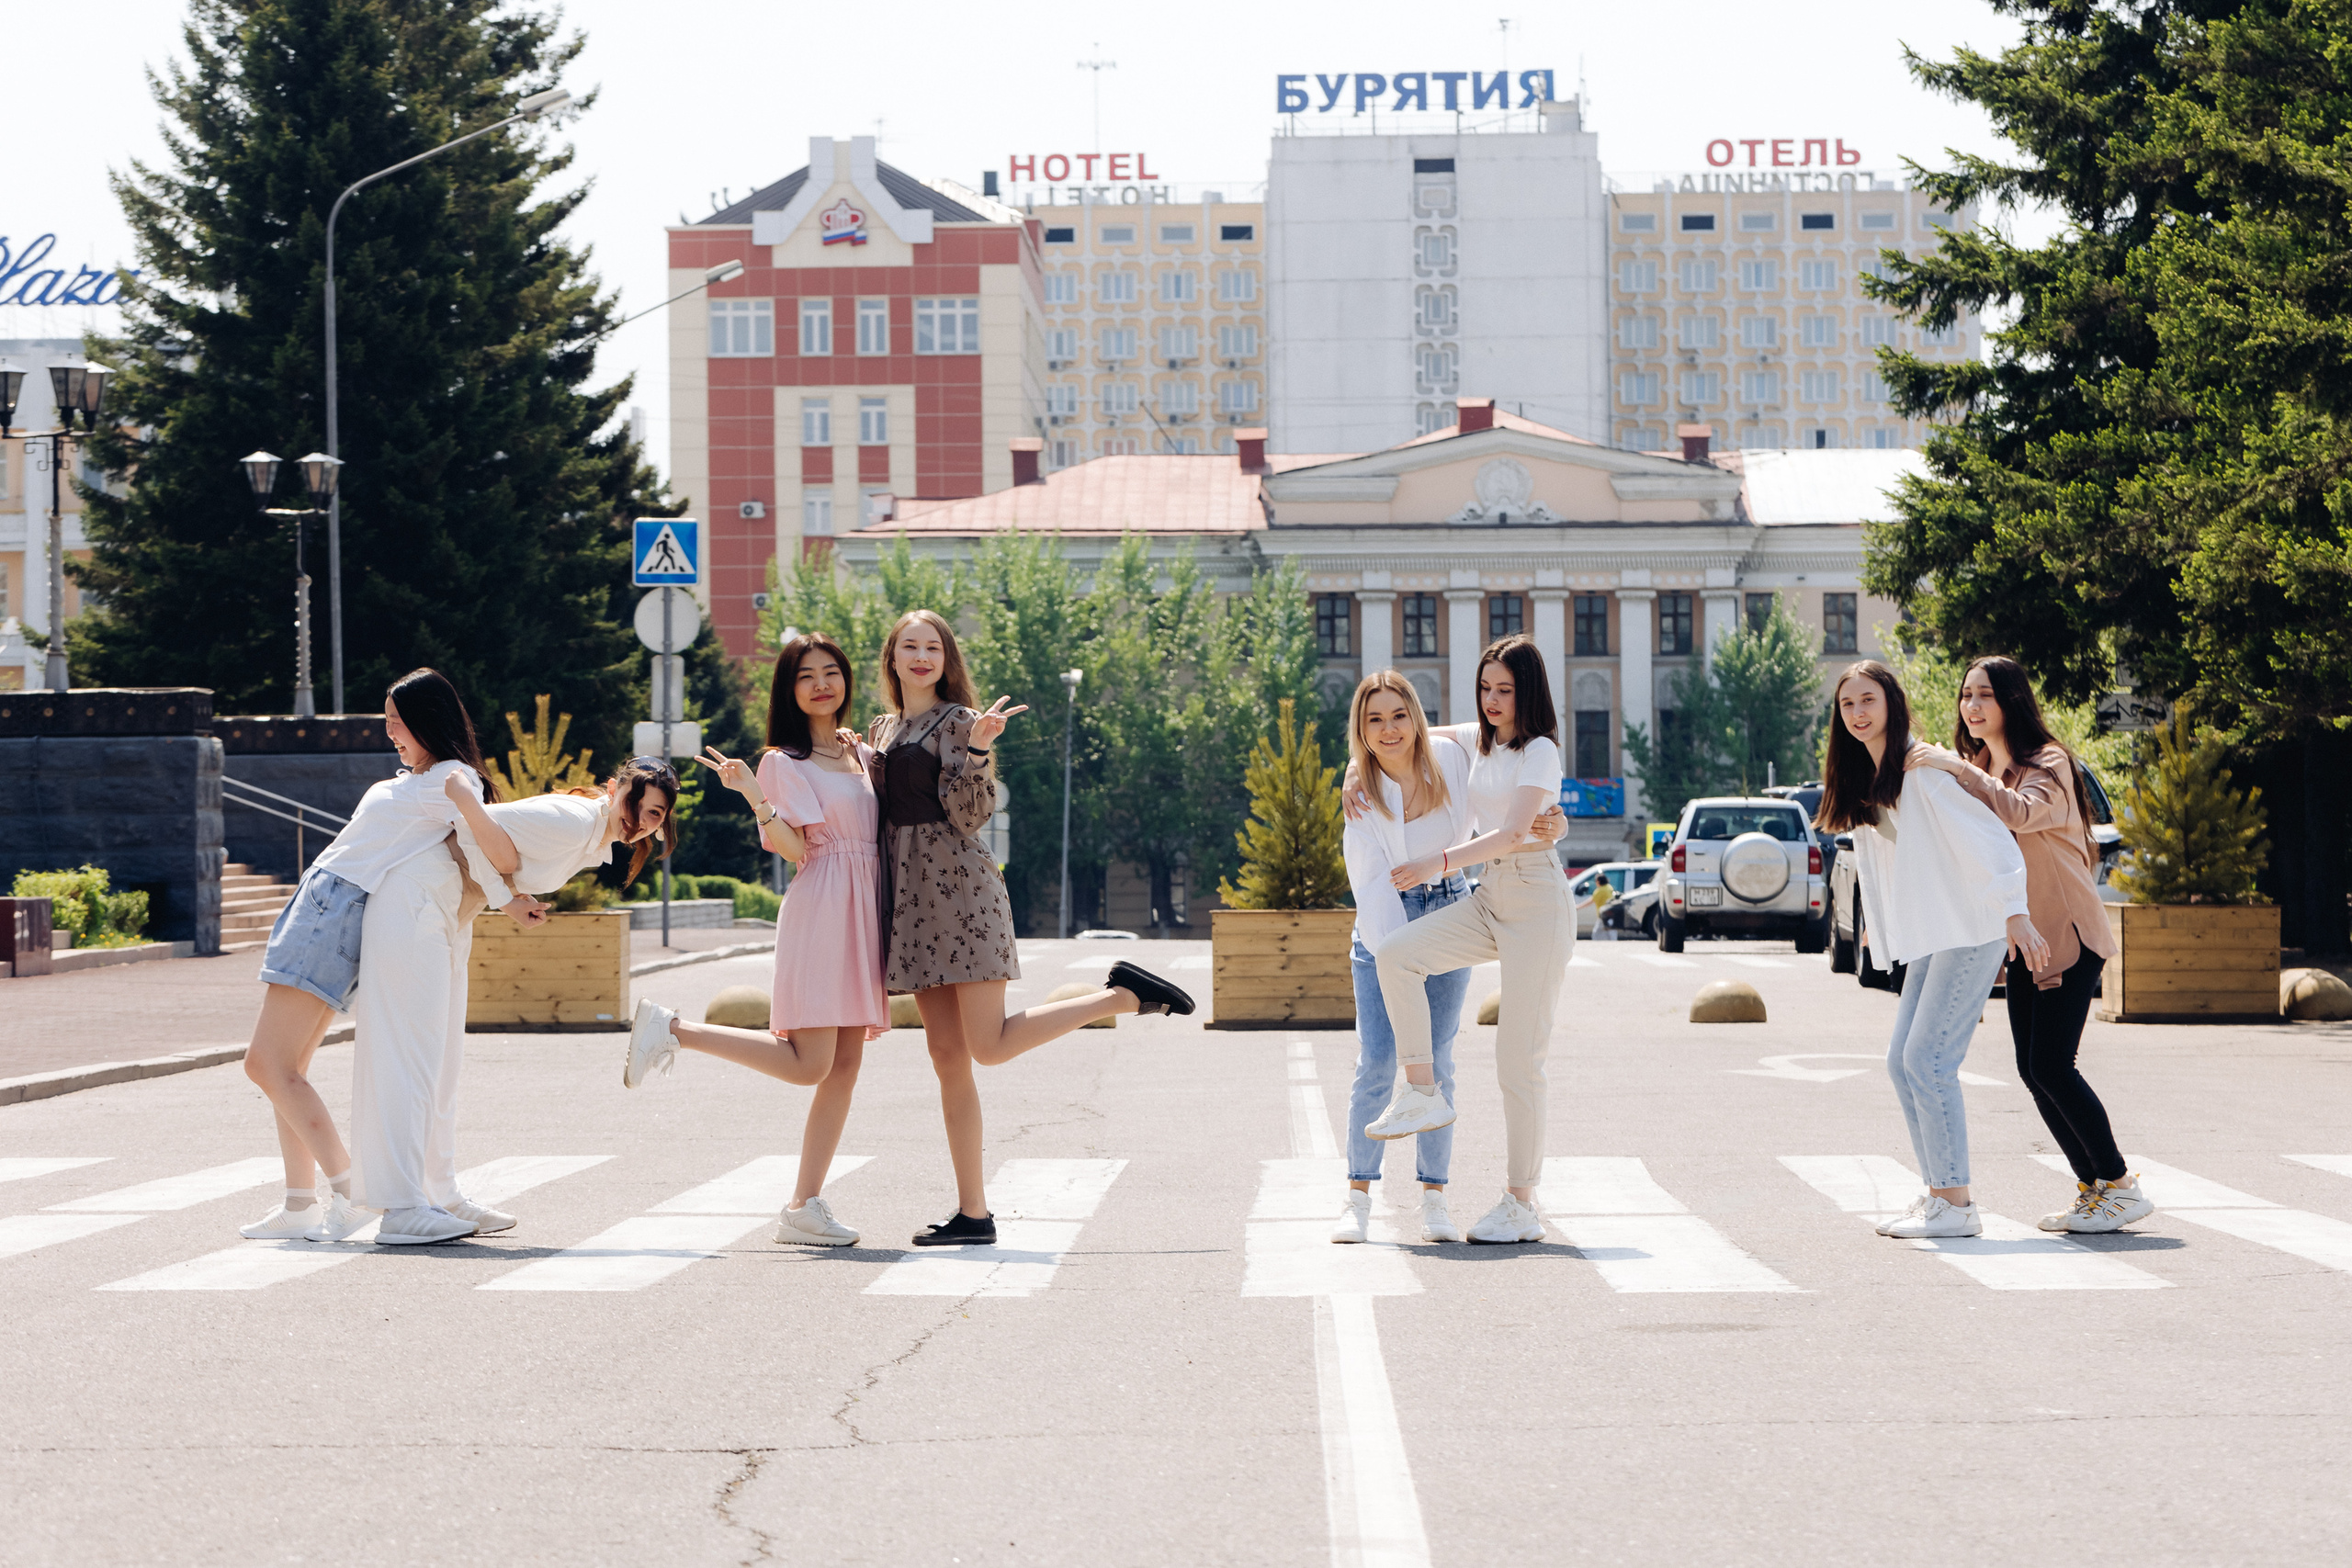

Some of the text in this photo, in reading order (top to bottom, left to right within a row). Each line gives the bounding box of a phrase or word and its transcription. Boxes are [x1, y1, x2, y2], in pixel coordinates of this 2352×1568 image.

[1277, 70, 1554, 113] БУРЯТИЯ
[1706, 138, 1861, 166] ОТЕЛЬ
[1010, 153, 1159, 182] HOTEL
